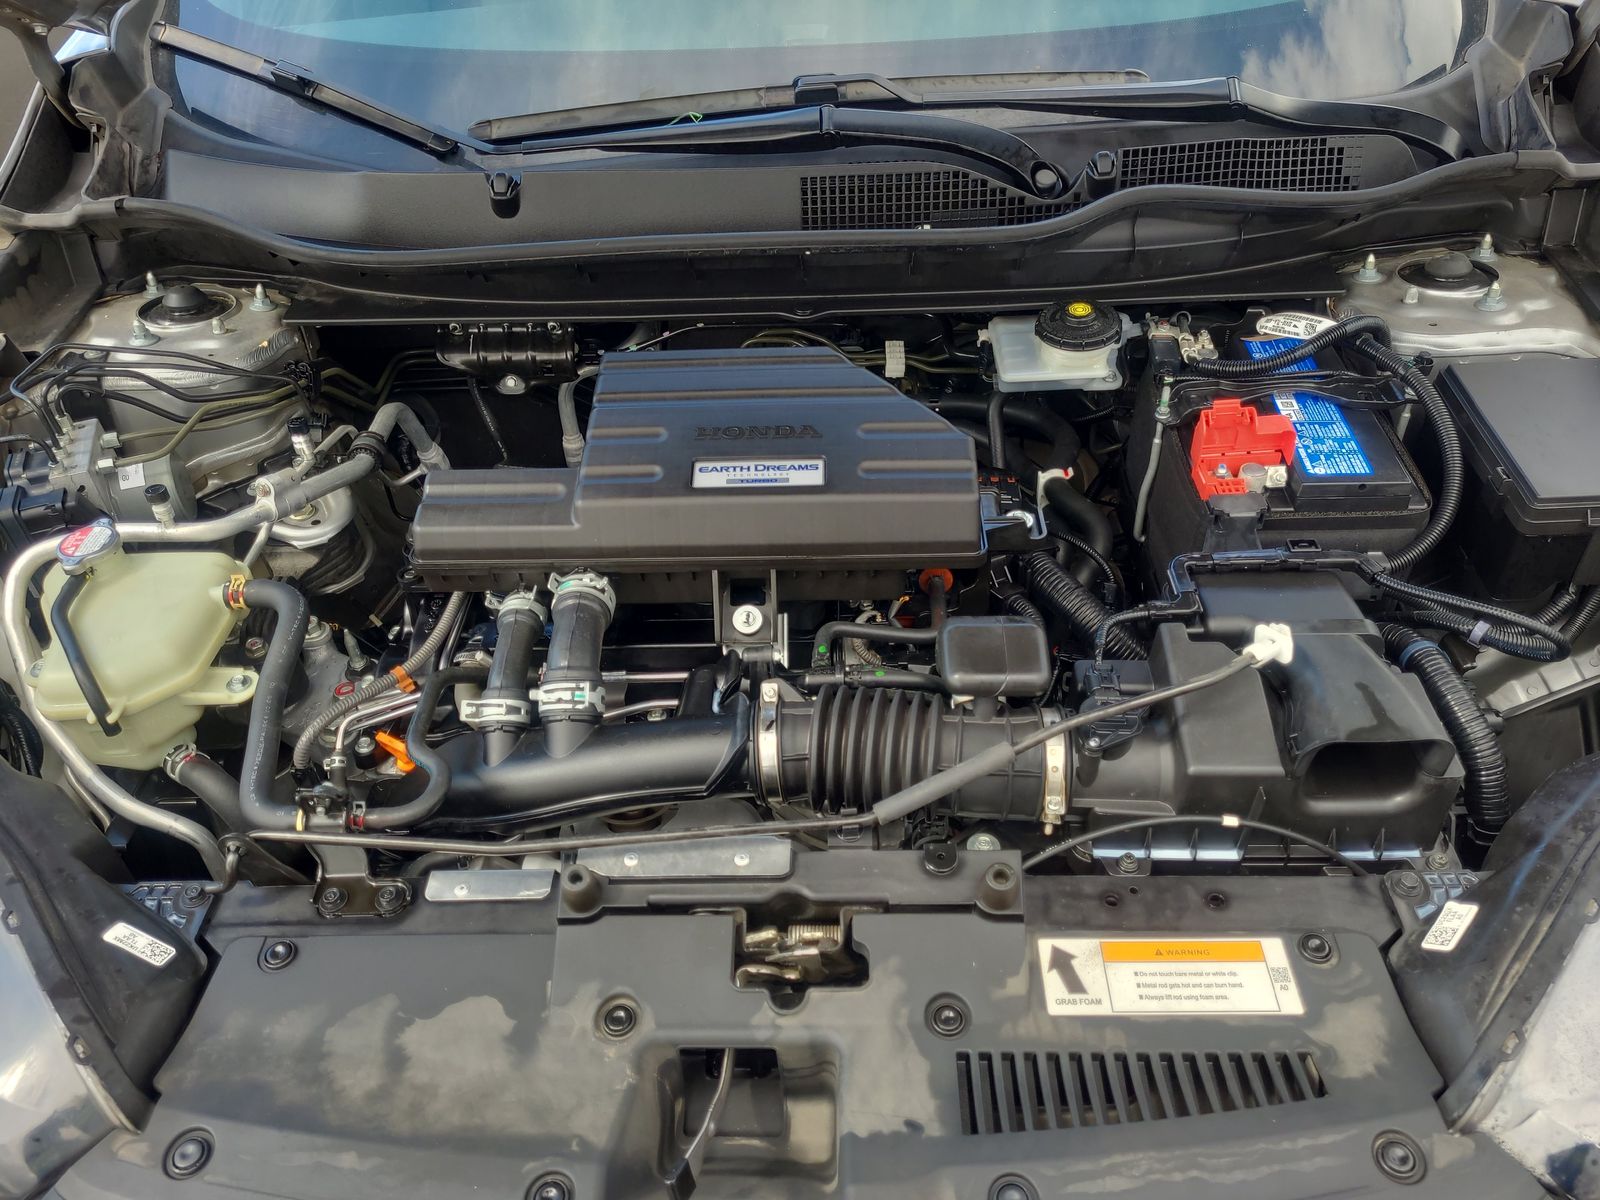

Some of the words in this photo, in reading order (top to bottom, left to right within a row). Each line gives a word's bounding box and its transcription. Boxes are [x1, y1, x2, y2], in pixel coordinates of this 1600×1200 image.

[694, 424, 823, 441] HONDA
[698, 464, 752, 474] EARTH
[754, 463, 820, 473] DREAMS
[1169, 982, 1181, 990] gets
[1055, 998, 1078, 1006] GRAB
[1079, 998, 1103, 1006] FOAM
[1183, 994, 1199, 1002] using
